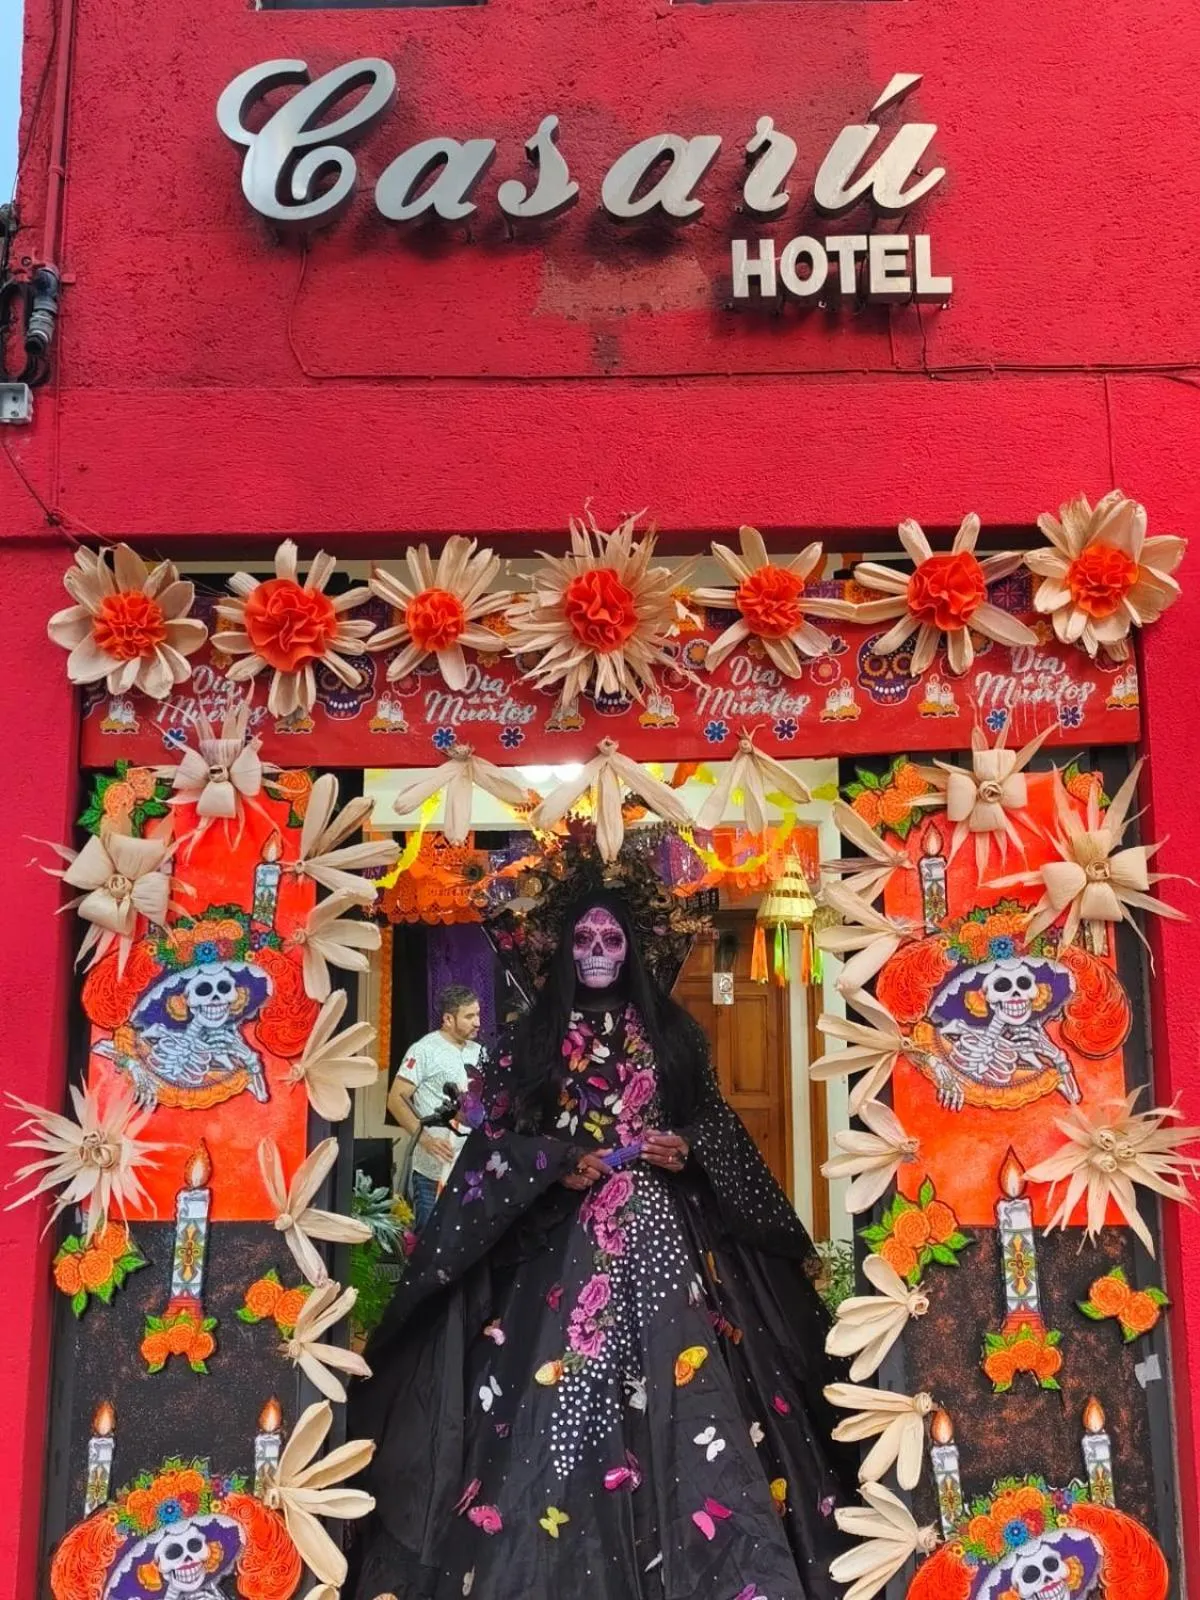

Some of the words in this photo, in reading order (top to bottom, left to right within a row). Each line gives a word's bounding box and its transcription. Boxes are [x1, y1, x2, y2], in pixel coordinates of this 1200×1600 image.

[216, 56, 948, 221] Casarú
[731, 233, 953, 299] HOTEL
[425, 690, 537, 726] Muertos
[696, 684, 811, 719] Muertos
